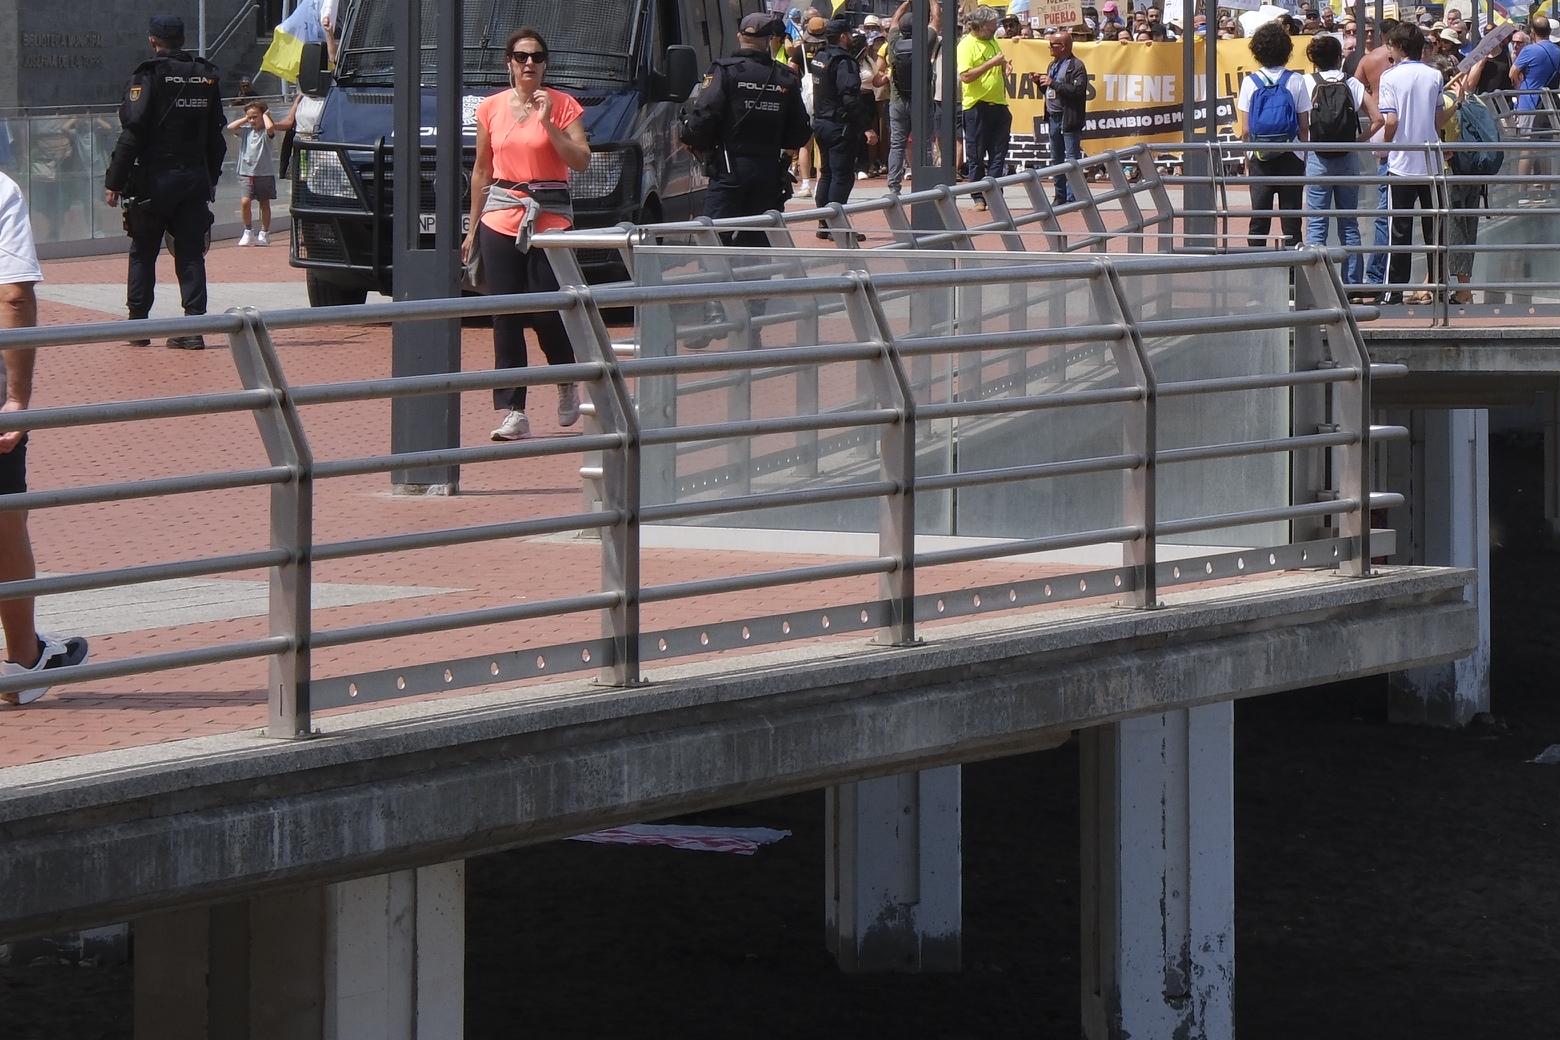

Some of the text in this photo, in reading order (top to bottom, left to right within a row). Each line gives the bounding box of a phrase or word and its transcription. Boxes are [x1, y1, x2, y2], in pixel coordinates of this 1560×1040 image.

[1044, 10, 1076, 25] PUEBLO
[165, 76, 208, 84] POLICIA
[737, 81, 783, 93] POLICIA
[1103, 73, 1176, 103] TIENE
[1098, 116, 1152, 130] CAMBIO
[1154, 113, 1171, 126] DE
